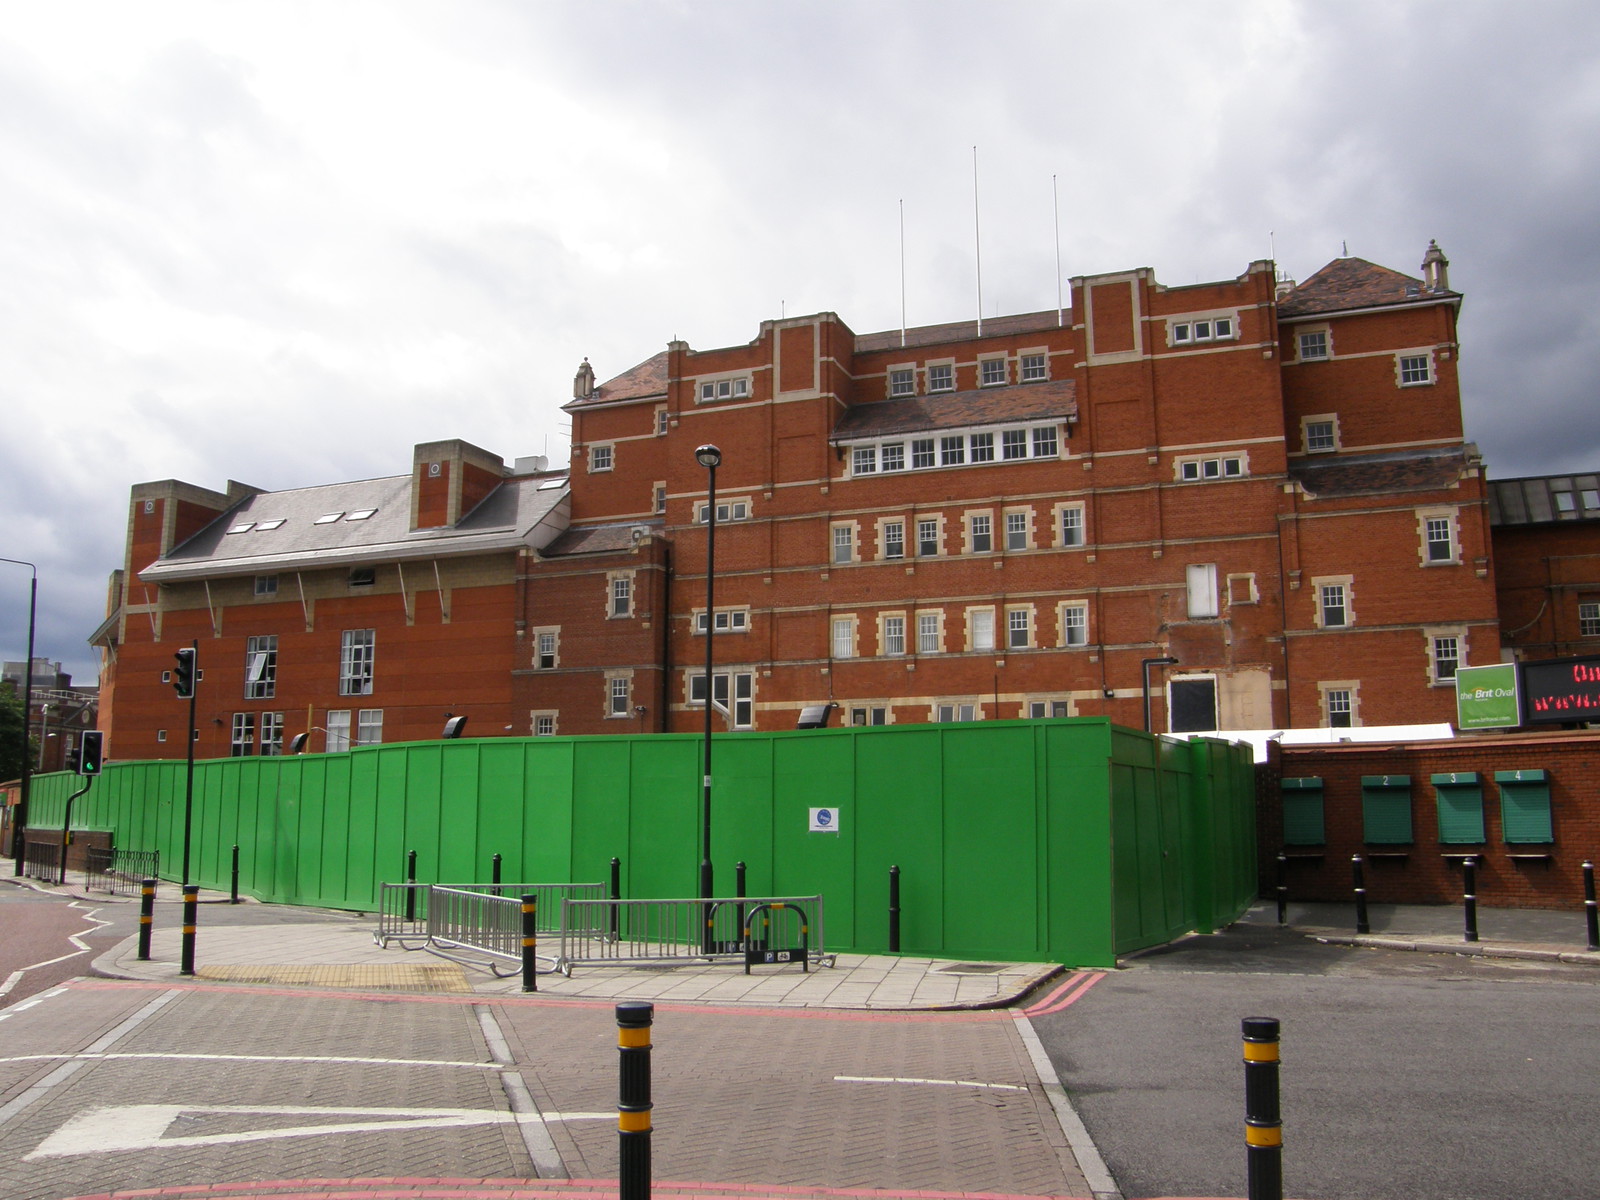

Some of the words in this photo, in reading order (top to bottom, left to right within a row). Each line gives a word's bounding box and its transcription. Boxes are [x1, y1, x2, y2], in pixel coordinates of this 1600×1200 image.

[1460, 692, 1473, 700] the
[1494, 687, 1515, 698] Oval
[1383, 775, 1389, 786] 2
[1450, 773, 1456, 783] 3
[1515, 770, 1521, 781] 4
[1299, 778, 1303, 788] 1
[766, 952, 772, 961] P
